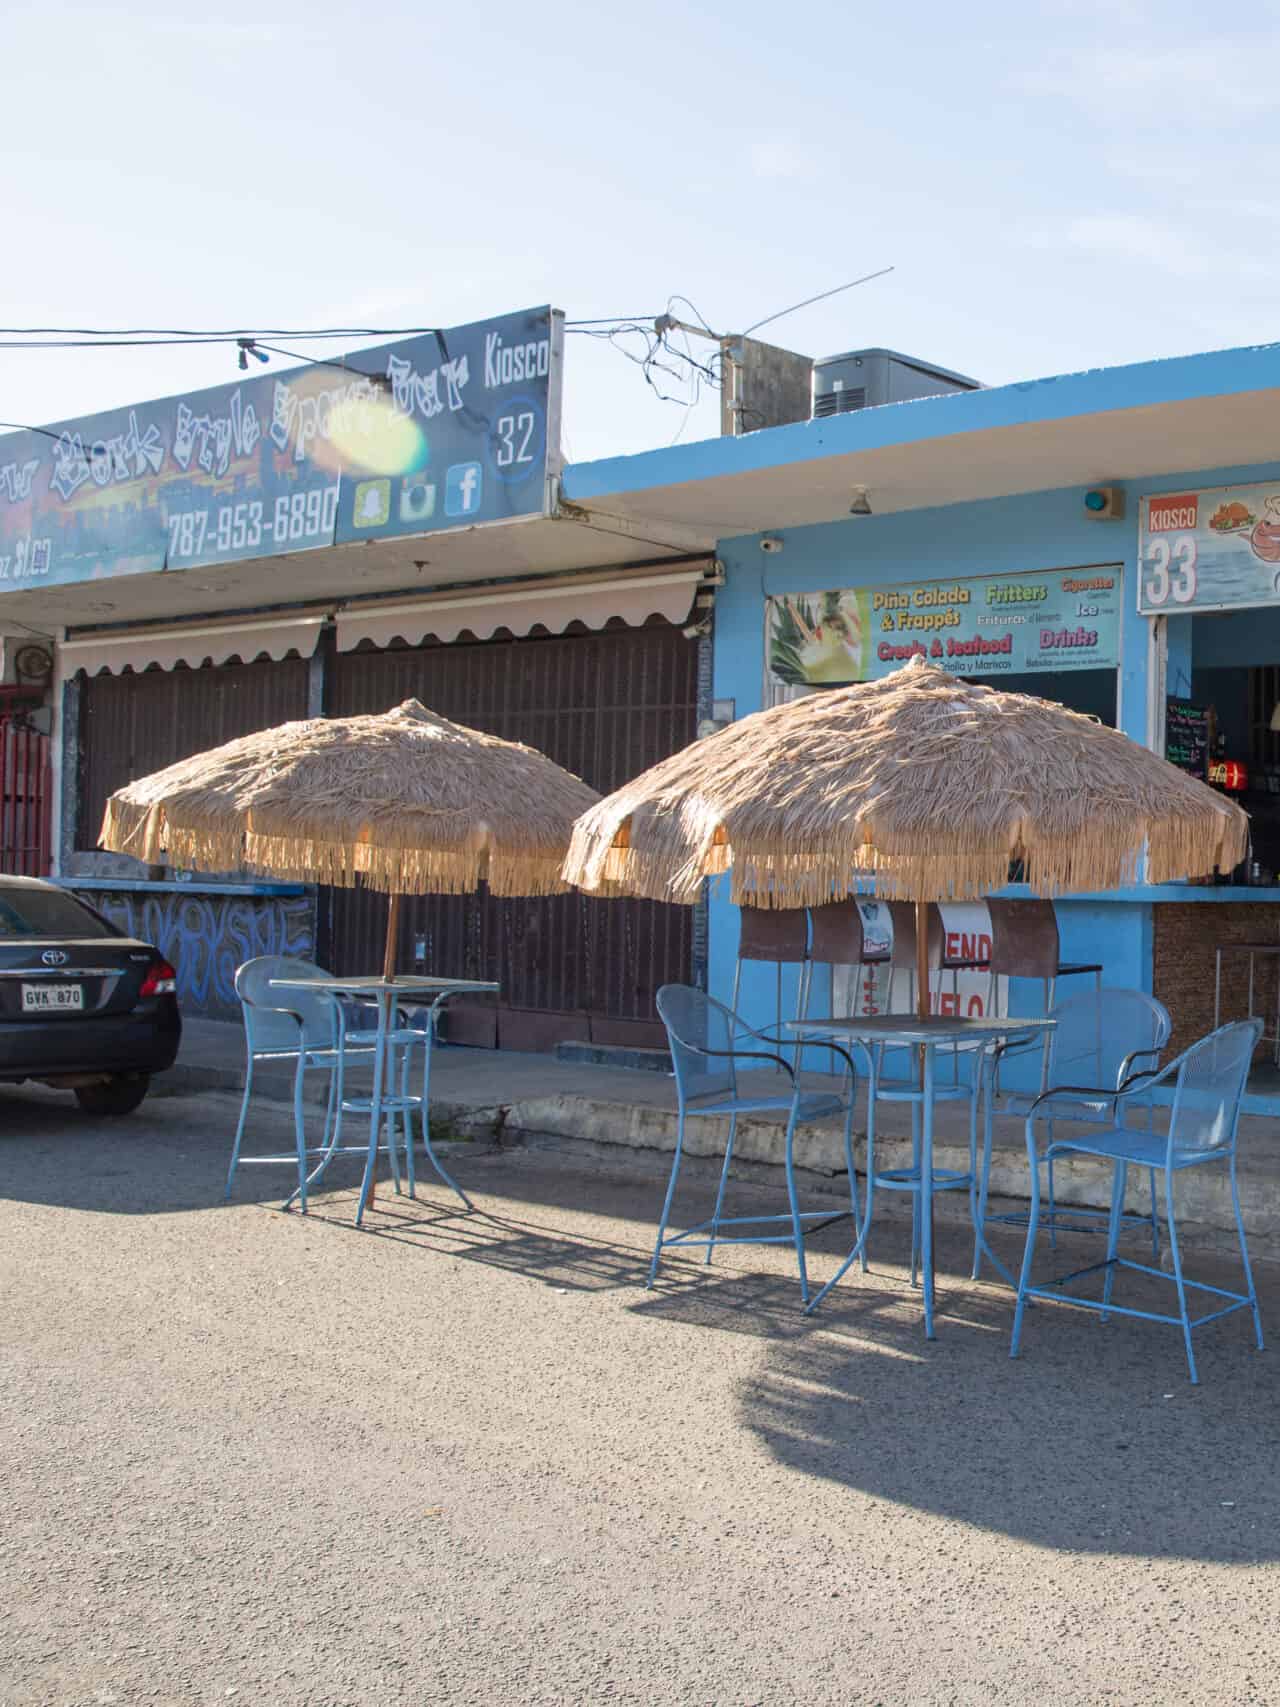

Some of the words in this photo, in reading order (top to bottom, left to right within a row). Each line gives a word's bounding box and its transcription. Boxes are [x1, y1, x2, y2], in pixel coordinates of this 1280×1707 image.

[484, 331, 549, 388] Kiosco
[386, 354, 470, 422] Bar
[497, 412, 535, 466] 32
[168, 486, 338, 557] 787-953-6890
[1150, 507, 1197, 532] KIOSCO
[1146, 536, 1198, 605] 33
[873, 591, 910, 610] Piña
[912, 585, 970, 608] Colada
[985, 583, 1048, 605] Fritters
[880, 613, 896, 632] &
[897, 606, 960, 632] Frappés
[1075, 602, 1099, 617] Ice
[946, 632, 1013, 657] Seafood
[1039, 626, 1099, 649] Drinks
[57, 989, 80, 1003] 870
